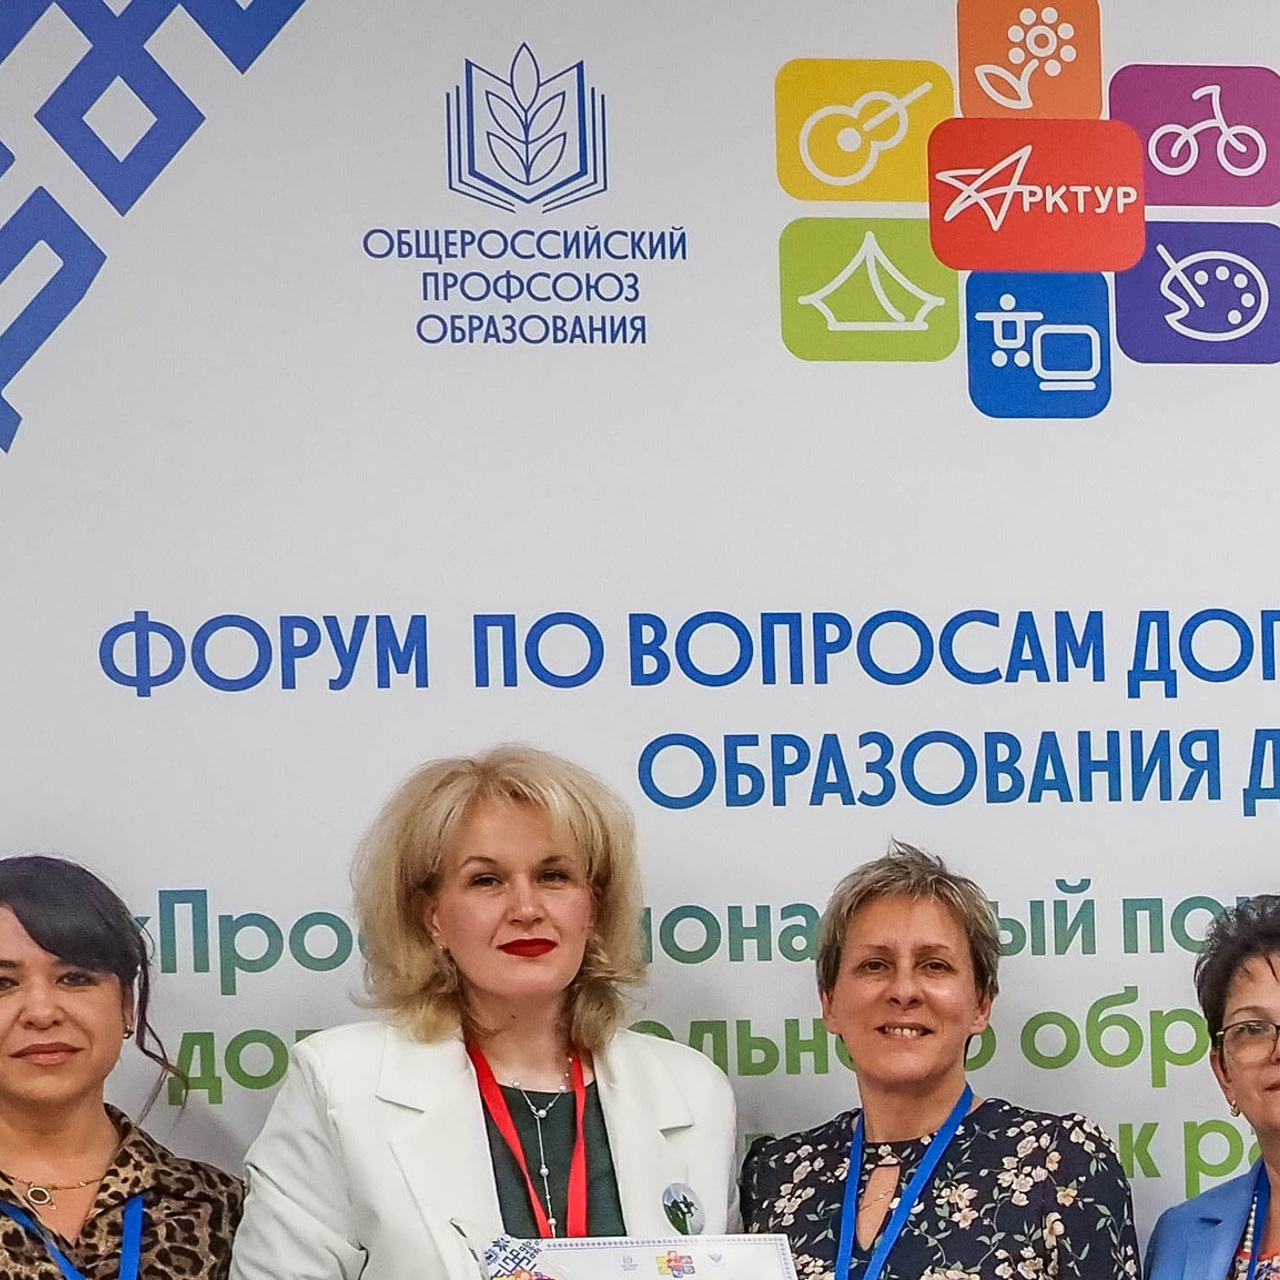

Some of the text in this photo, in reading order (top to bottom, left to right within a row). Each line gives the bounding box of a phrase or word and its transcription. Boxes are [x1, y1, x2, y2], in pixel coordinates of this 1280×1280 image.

[362, 228, 688, 261] ОБЩЕРОССИЙСКИЙ
[421, 270, 641, 303] ПРОФСОЮЗ
[415, 312, 648, 345] ОБРАЗОВАНИЯ
[98, 610, 429, 698] ФОРУМ
[473, 612, 604, 689] ПО
[630, 609, 1104, 687] ВОПРОСАМ
[637, 728, 1221, 810] ОБРАЗОВАНИЯ
